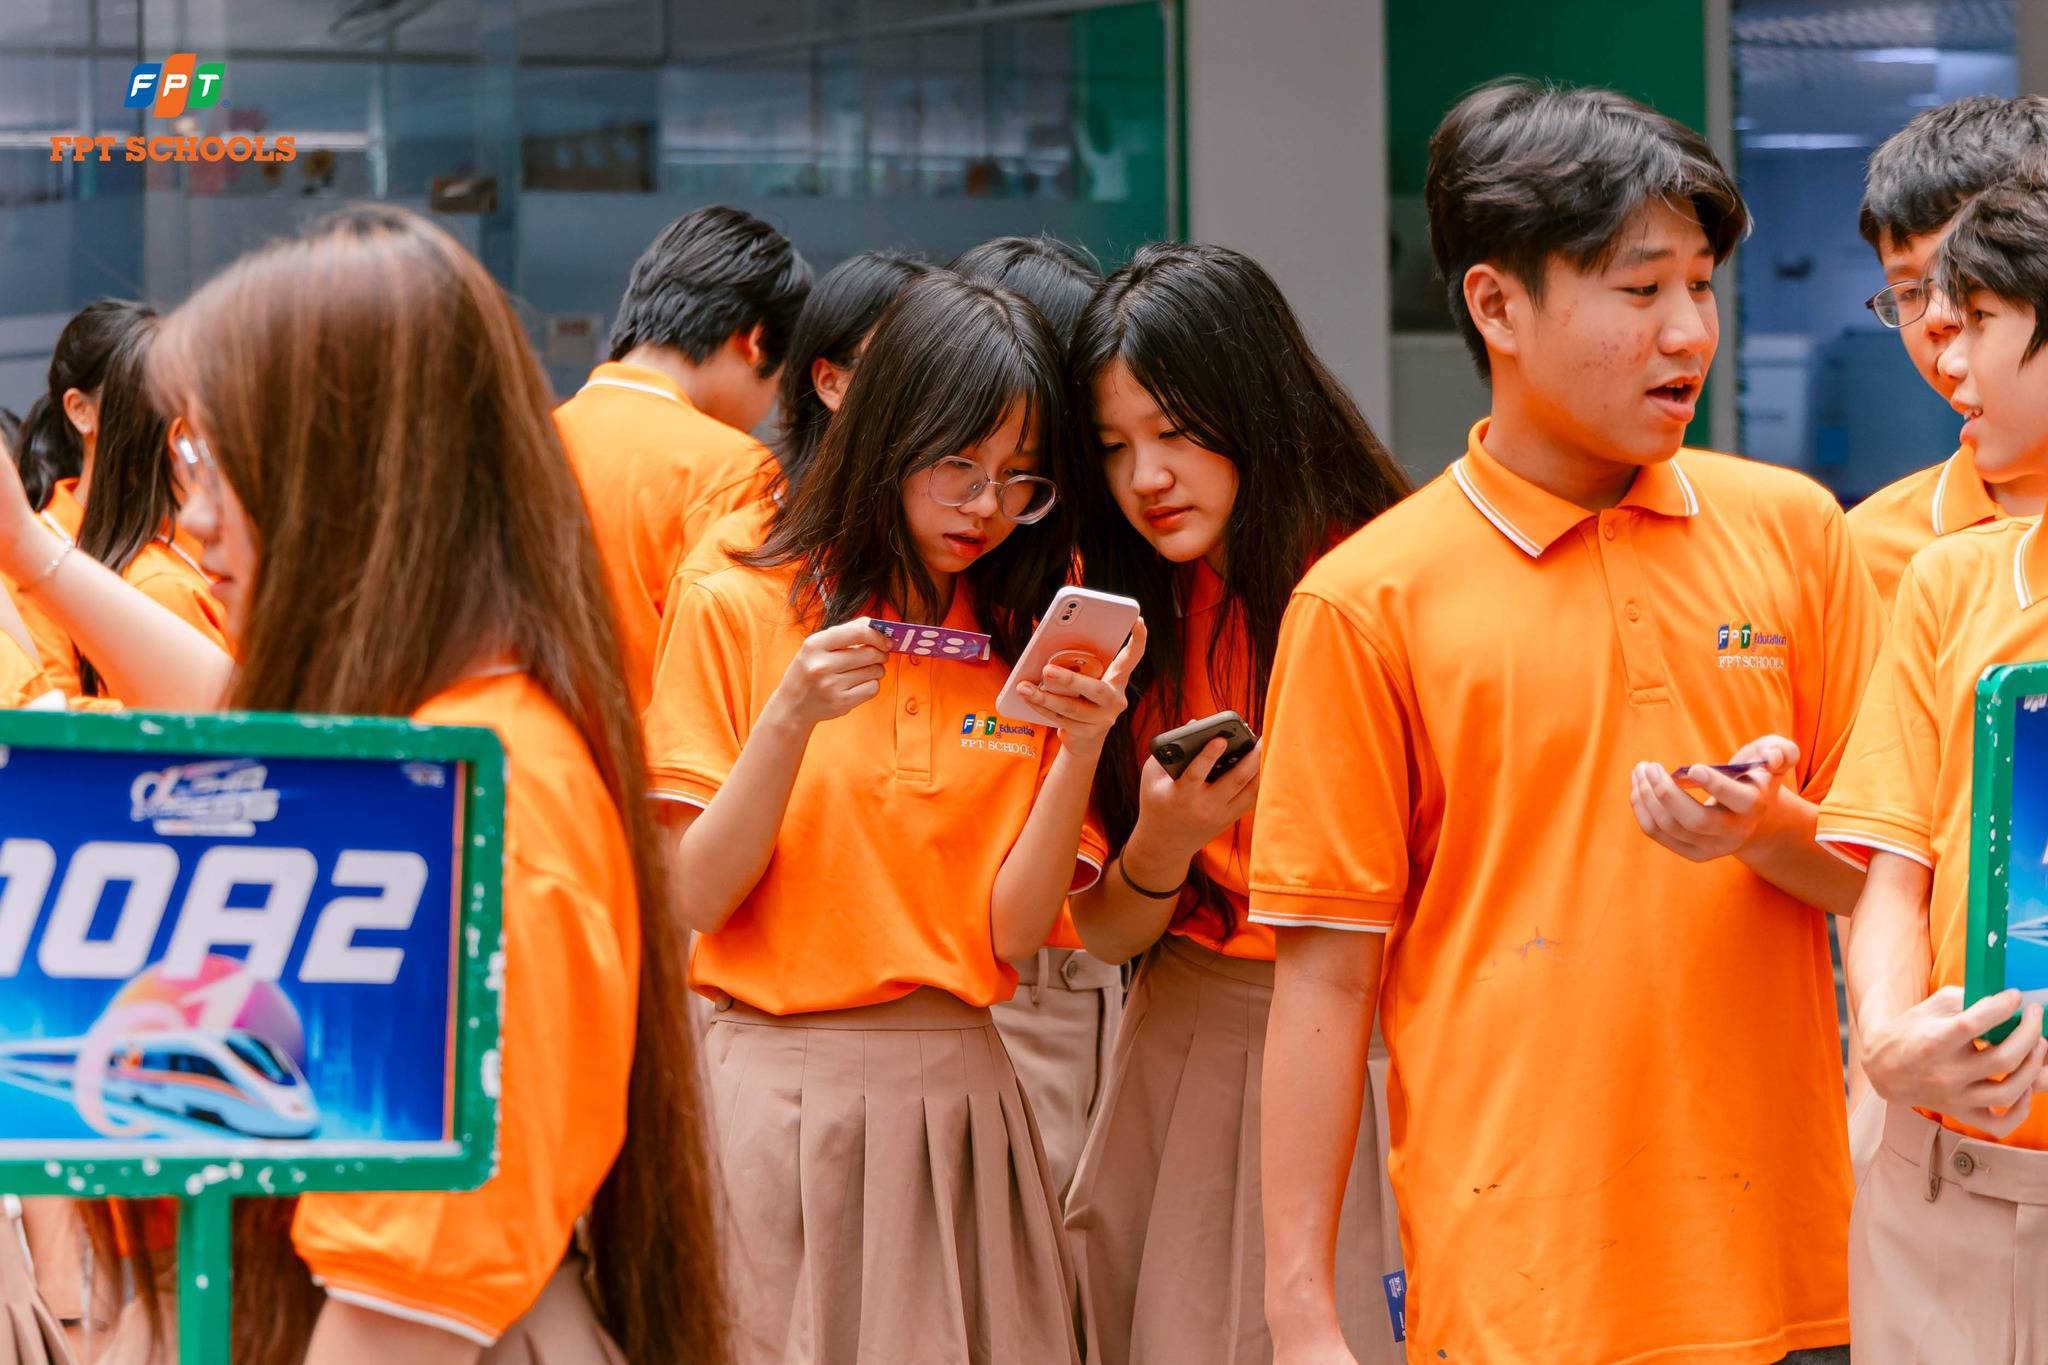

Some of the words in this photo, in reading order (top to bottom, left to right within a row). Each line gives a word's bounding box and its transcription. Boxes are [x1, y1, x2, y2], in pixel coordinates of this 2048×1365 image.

[1718, 655, 1741, 668] FPT
[961, 738, 985, 748] FPT
[0, 838, 429, 984] 10A2
